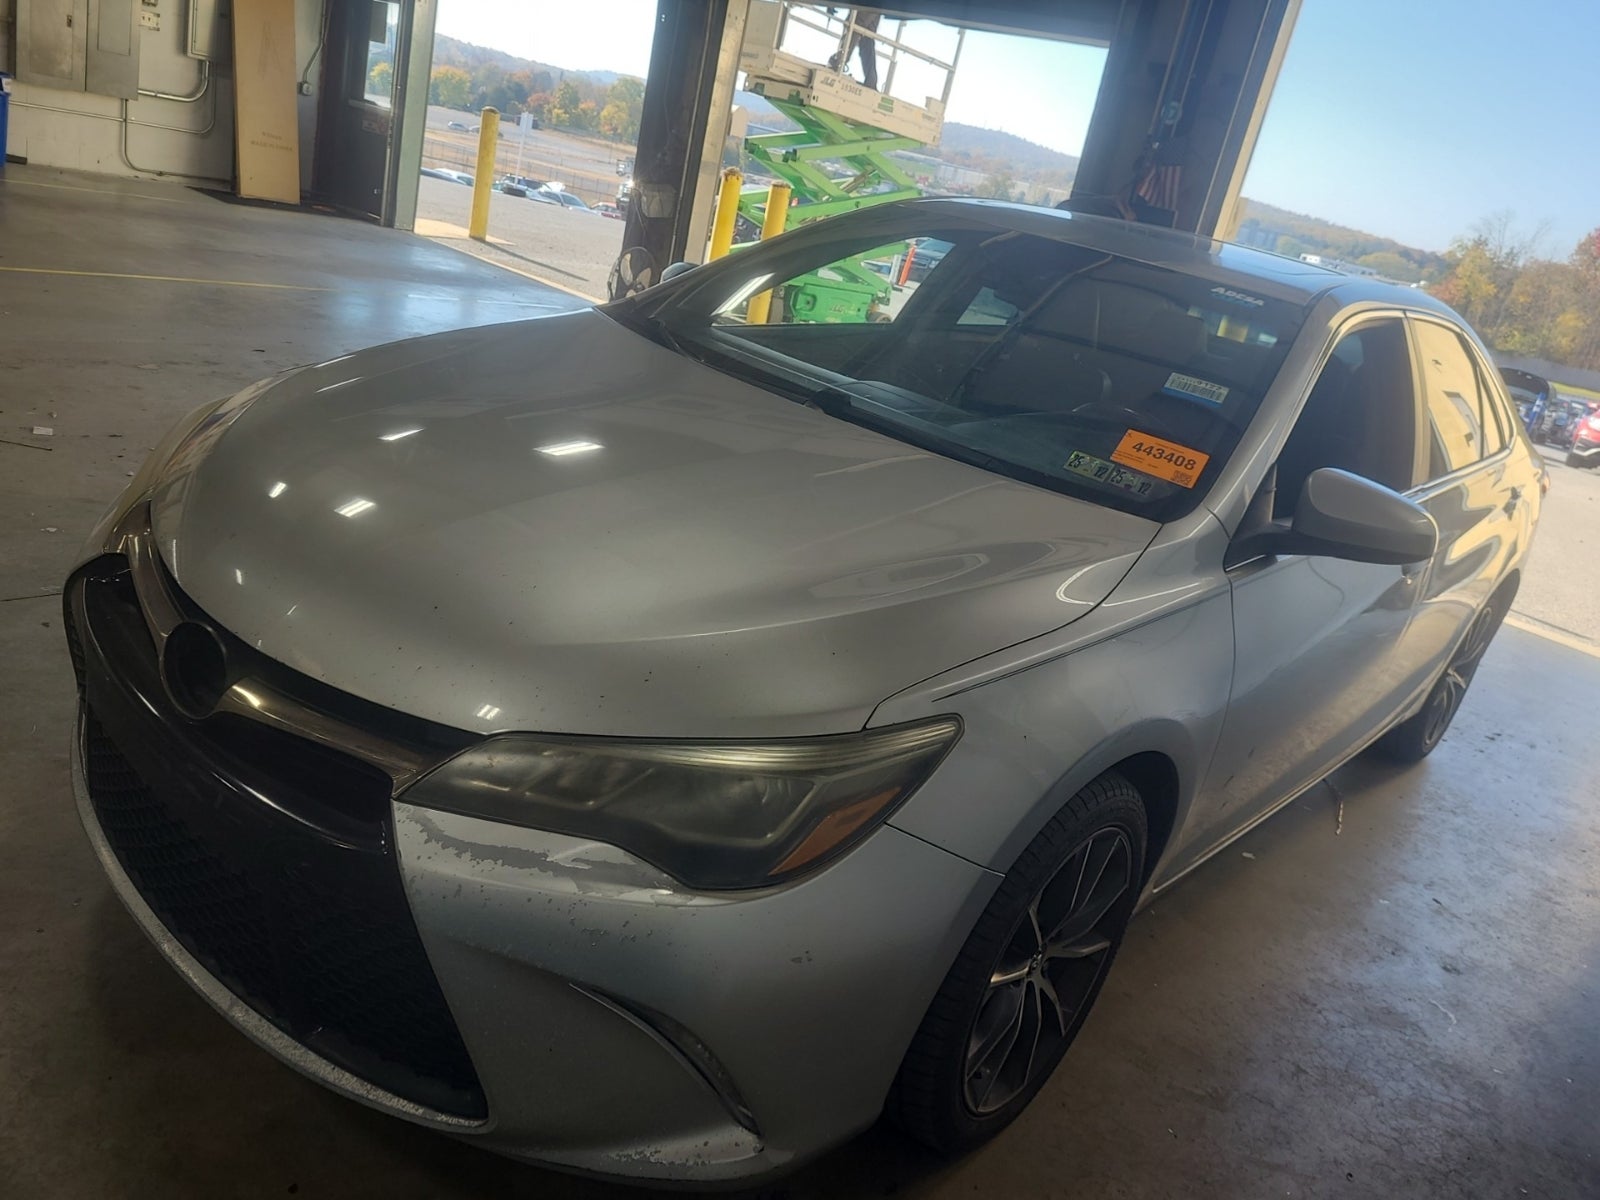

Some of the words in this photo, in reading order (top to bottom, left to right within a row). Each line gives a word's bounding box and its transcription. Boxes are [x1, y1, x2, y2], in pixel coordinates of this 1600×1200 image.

[1210, 286, 1265, 306] ADESA
[1068, 454, 1084, 469] 25
[1094, 466, 1108, 478] 12
[1132, 442, 1197, 471] 443408
[1111, 470, 1126, 484] 25
[1138, 482, 1152, 495] 12
